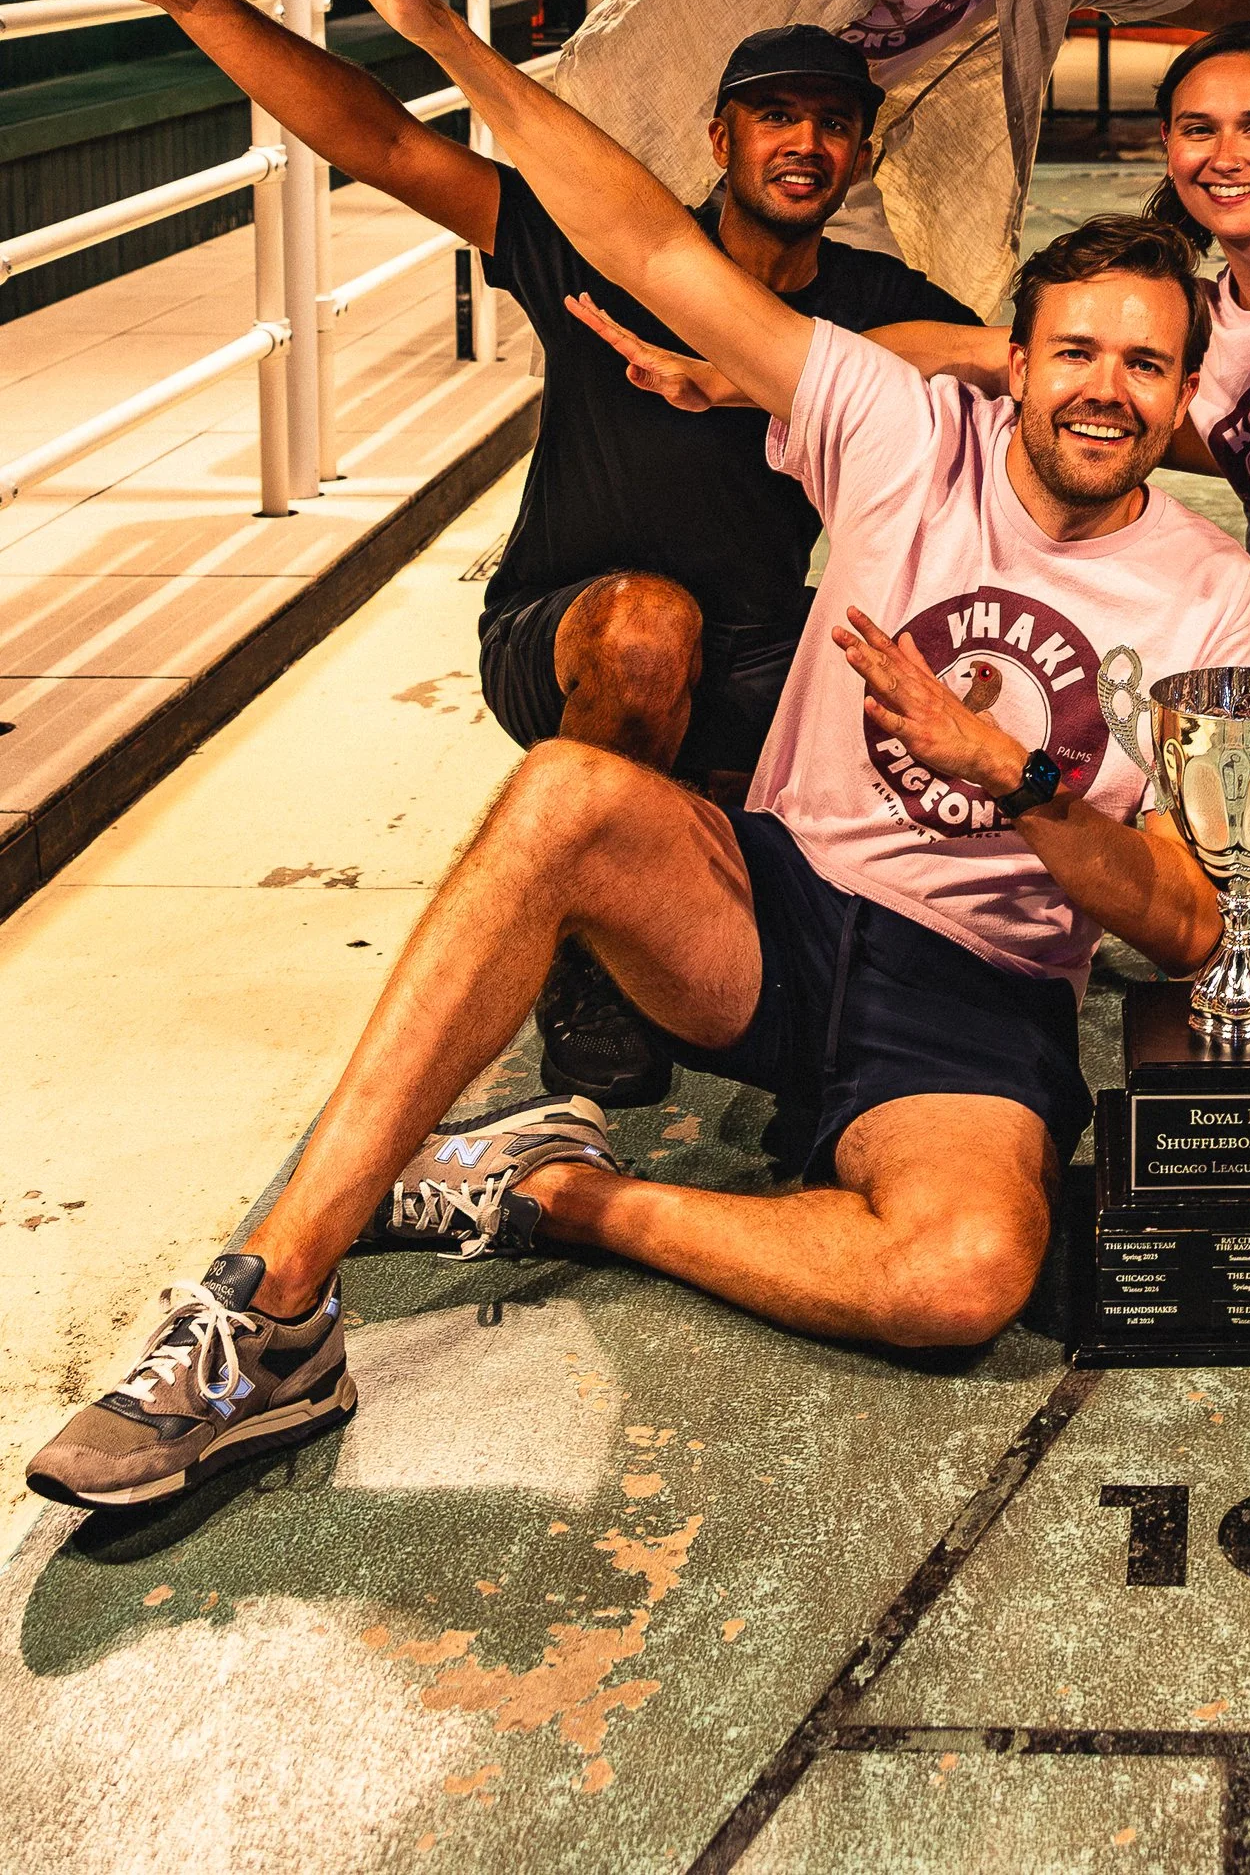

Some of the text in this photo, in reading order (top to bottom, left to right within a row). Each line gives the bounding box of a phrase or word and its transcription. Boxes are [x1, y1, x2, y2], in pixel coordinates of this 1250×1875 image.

[1056, 745, 1092, 763] PALMS
[875, 737, 1011, 829] PIGEON
[872, 781, 905, 826] ALWAYS
[908, 824, 926, 837] ON
[434, 1136, 493, 1168] N
[1104, 1241, 1176, 1250] THE HOUSE TEAM
[1214, 1243, 1232, 1251] THE
[1121, 1253, 1142, 1262] Spring
[1115, 1274, 1166, 1282] CHICAGO SC
[1226, 1272, 1245, 1280] THE
[1103, 1305, 1178, 1314] THE HANDSHAKES
[1226, 1306, 1245, 1314] THE
[1126, 1317, 1138, 1325] Fall
